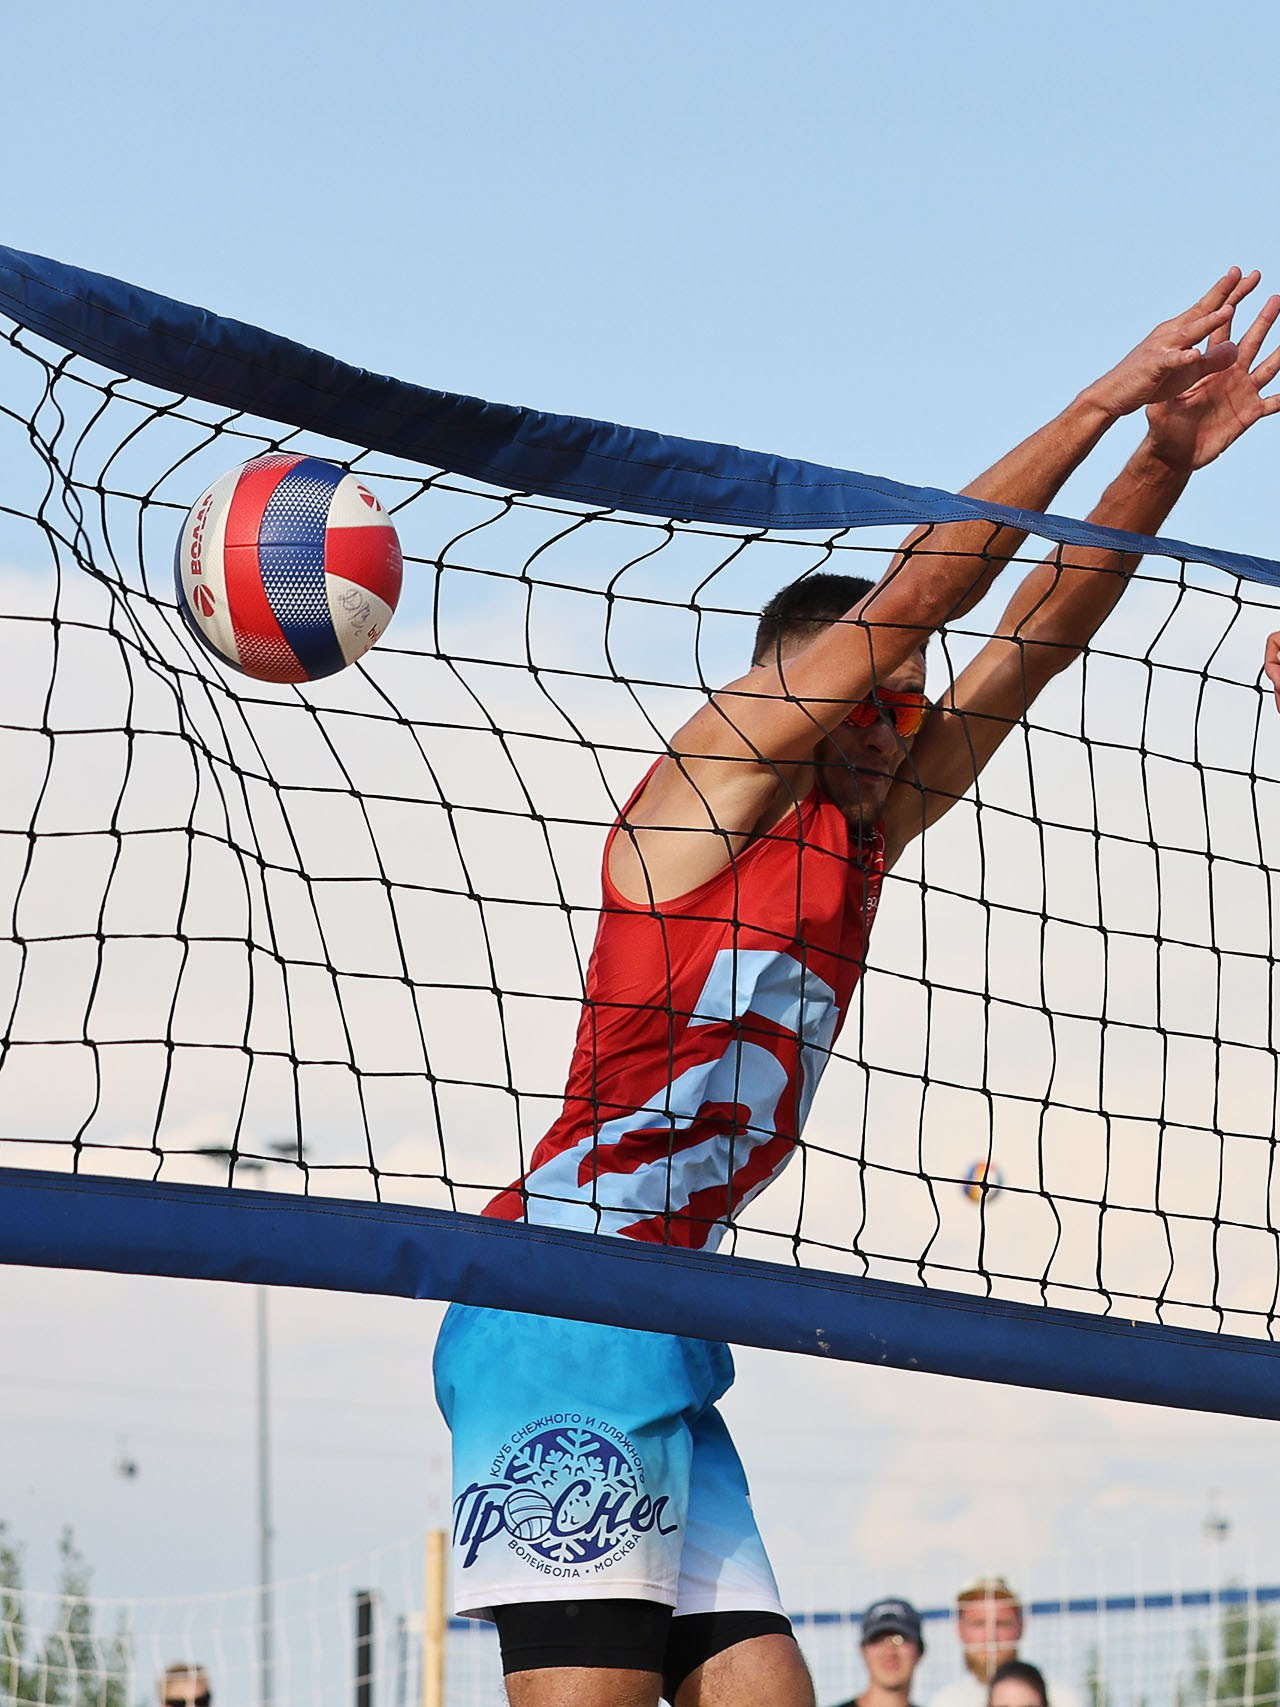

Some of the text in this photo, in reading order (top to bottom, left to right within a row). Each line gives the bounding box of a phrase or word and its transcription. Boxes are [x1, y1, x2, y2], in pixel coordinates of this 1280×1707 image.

[489, 1413, 646, 1484] КЛУБ СНЕЖНОГО И ПЛЯЖНОГО
[507, 1533, 642, 1578] ВОЛЕЙБОЛА МОСКВА
